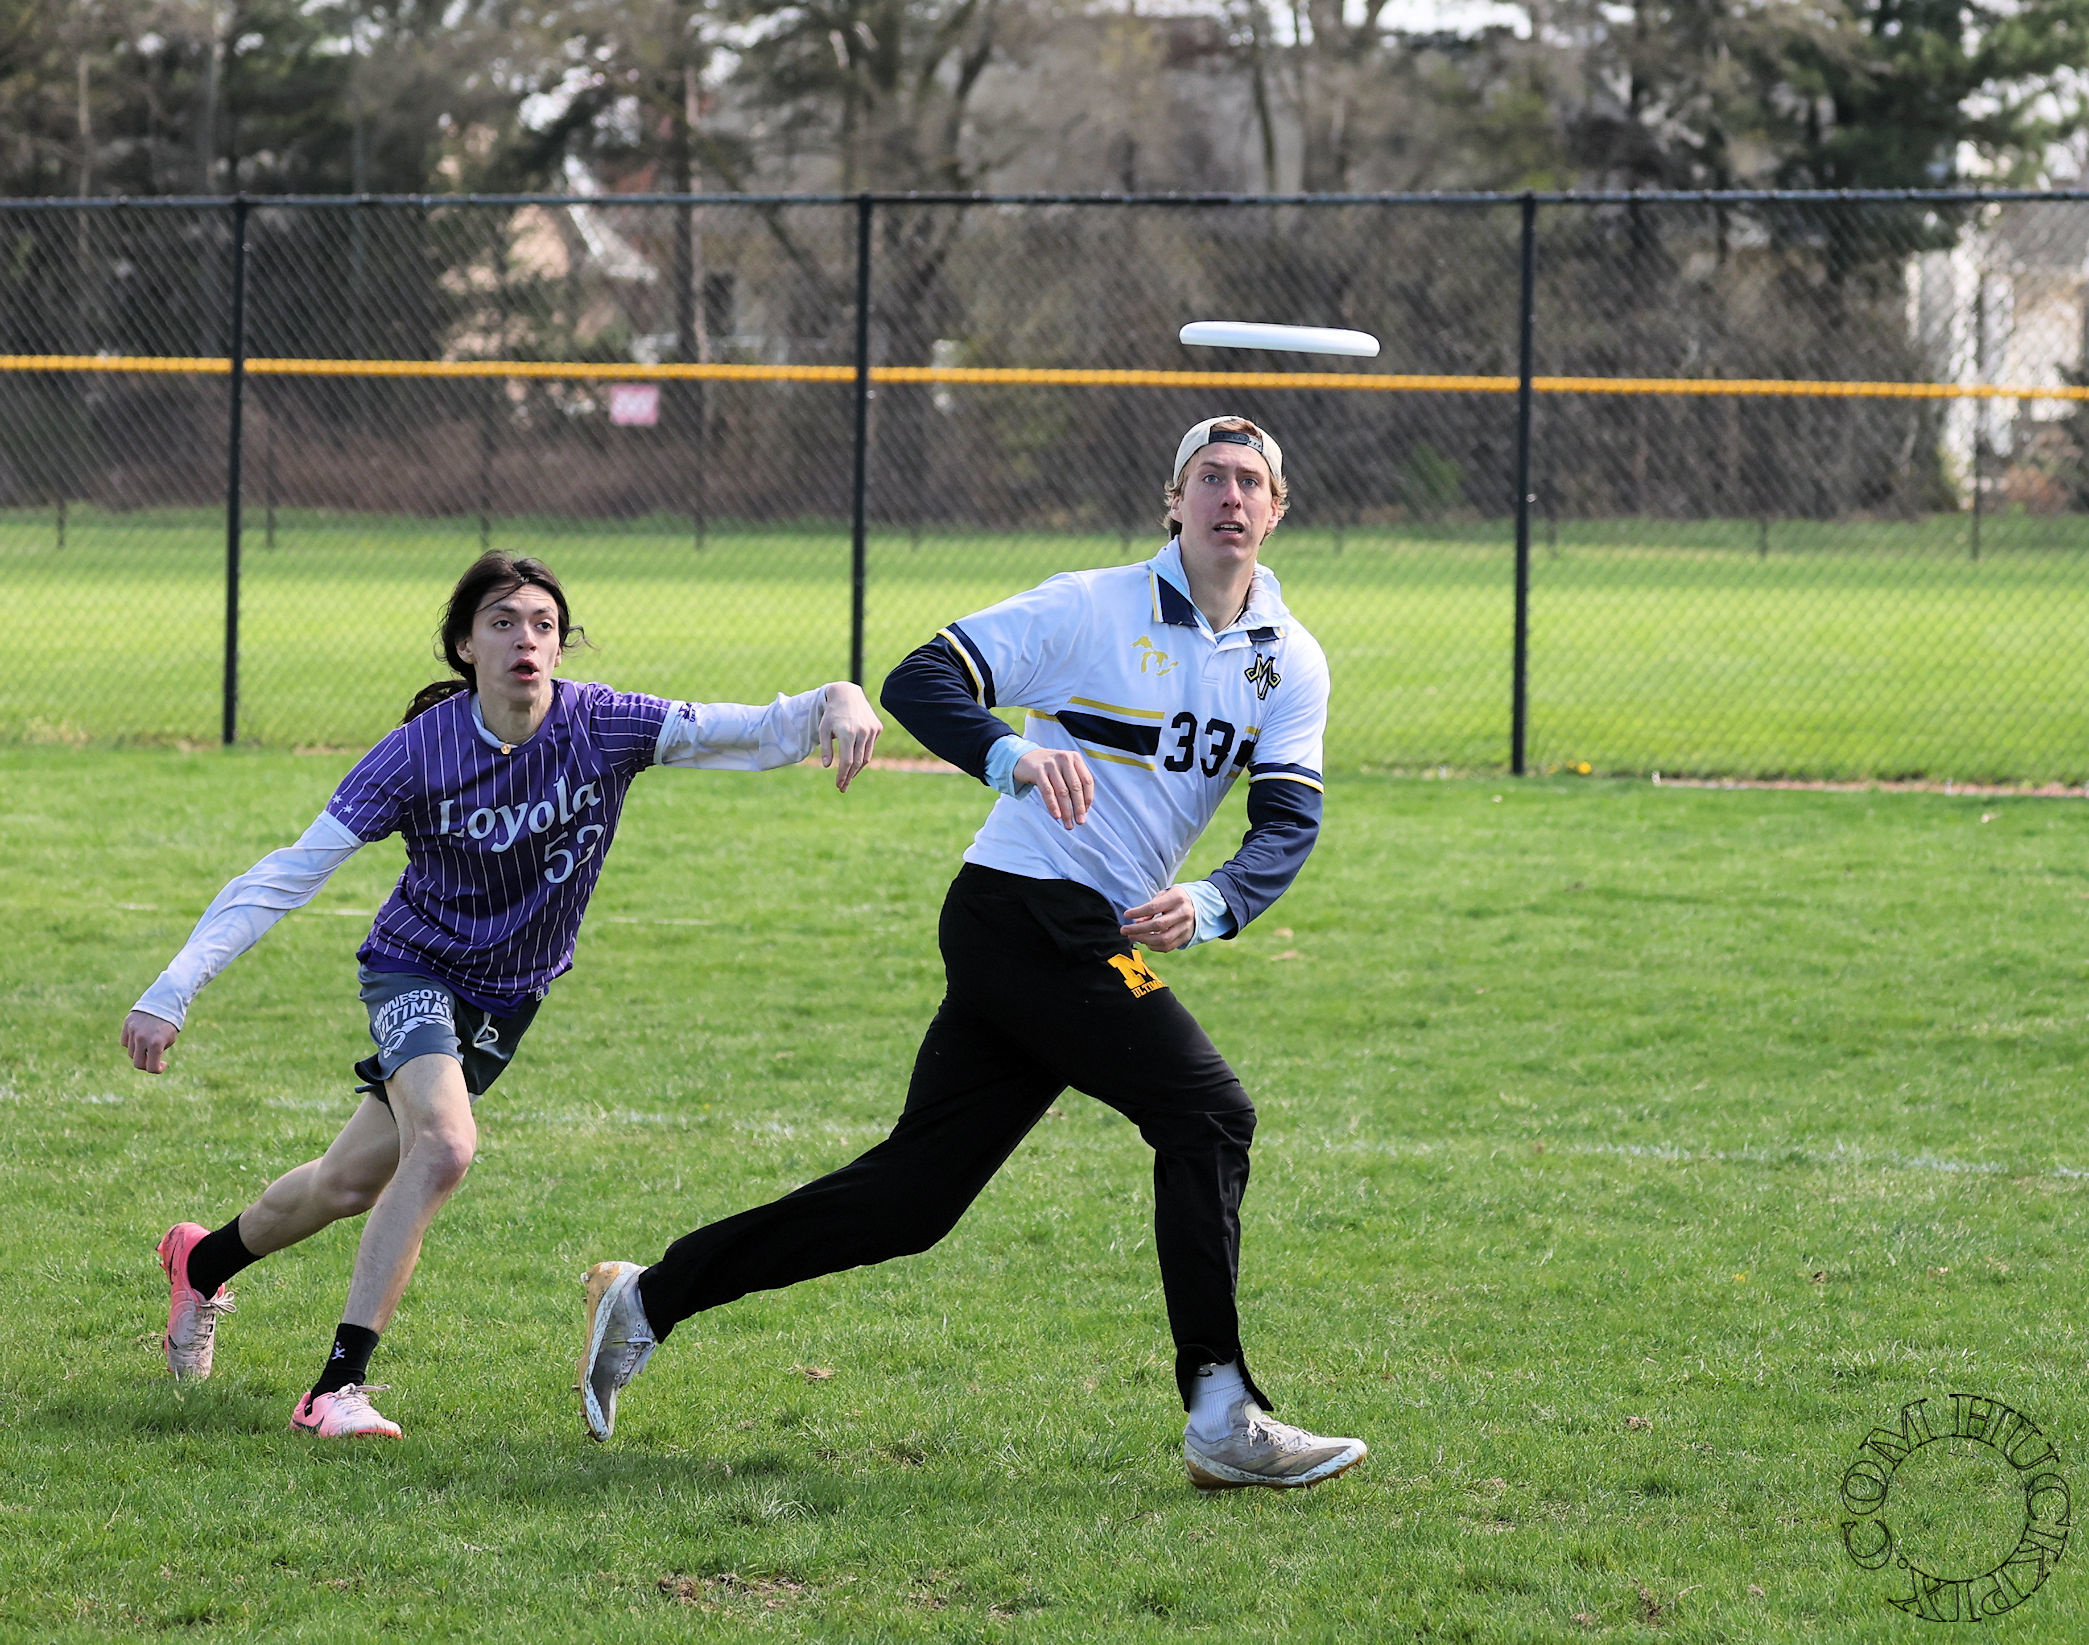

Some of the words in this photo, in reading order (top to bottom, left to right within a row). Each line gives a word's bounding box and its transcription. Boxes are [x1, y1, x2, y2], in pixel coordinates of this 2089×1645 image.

[1164, 711, 1236, 778] 33
[438, 775, 601, 854] Loyola
[1107, 949, 1161, 990] M
[378, 1000, 454, 1042] ULTIMAT
